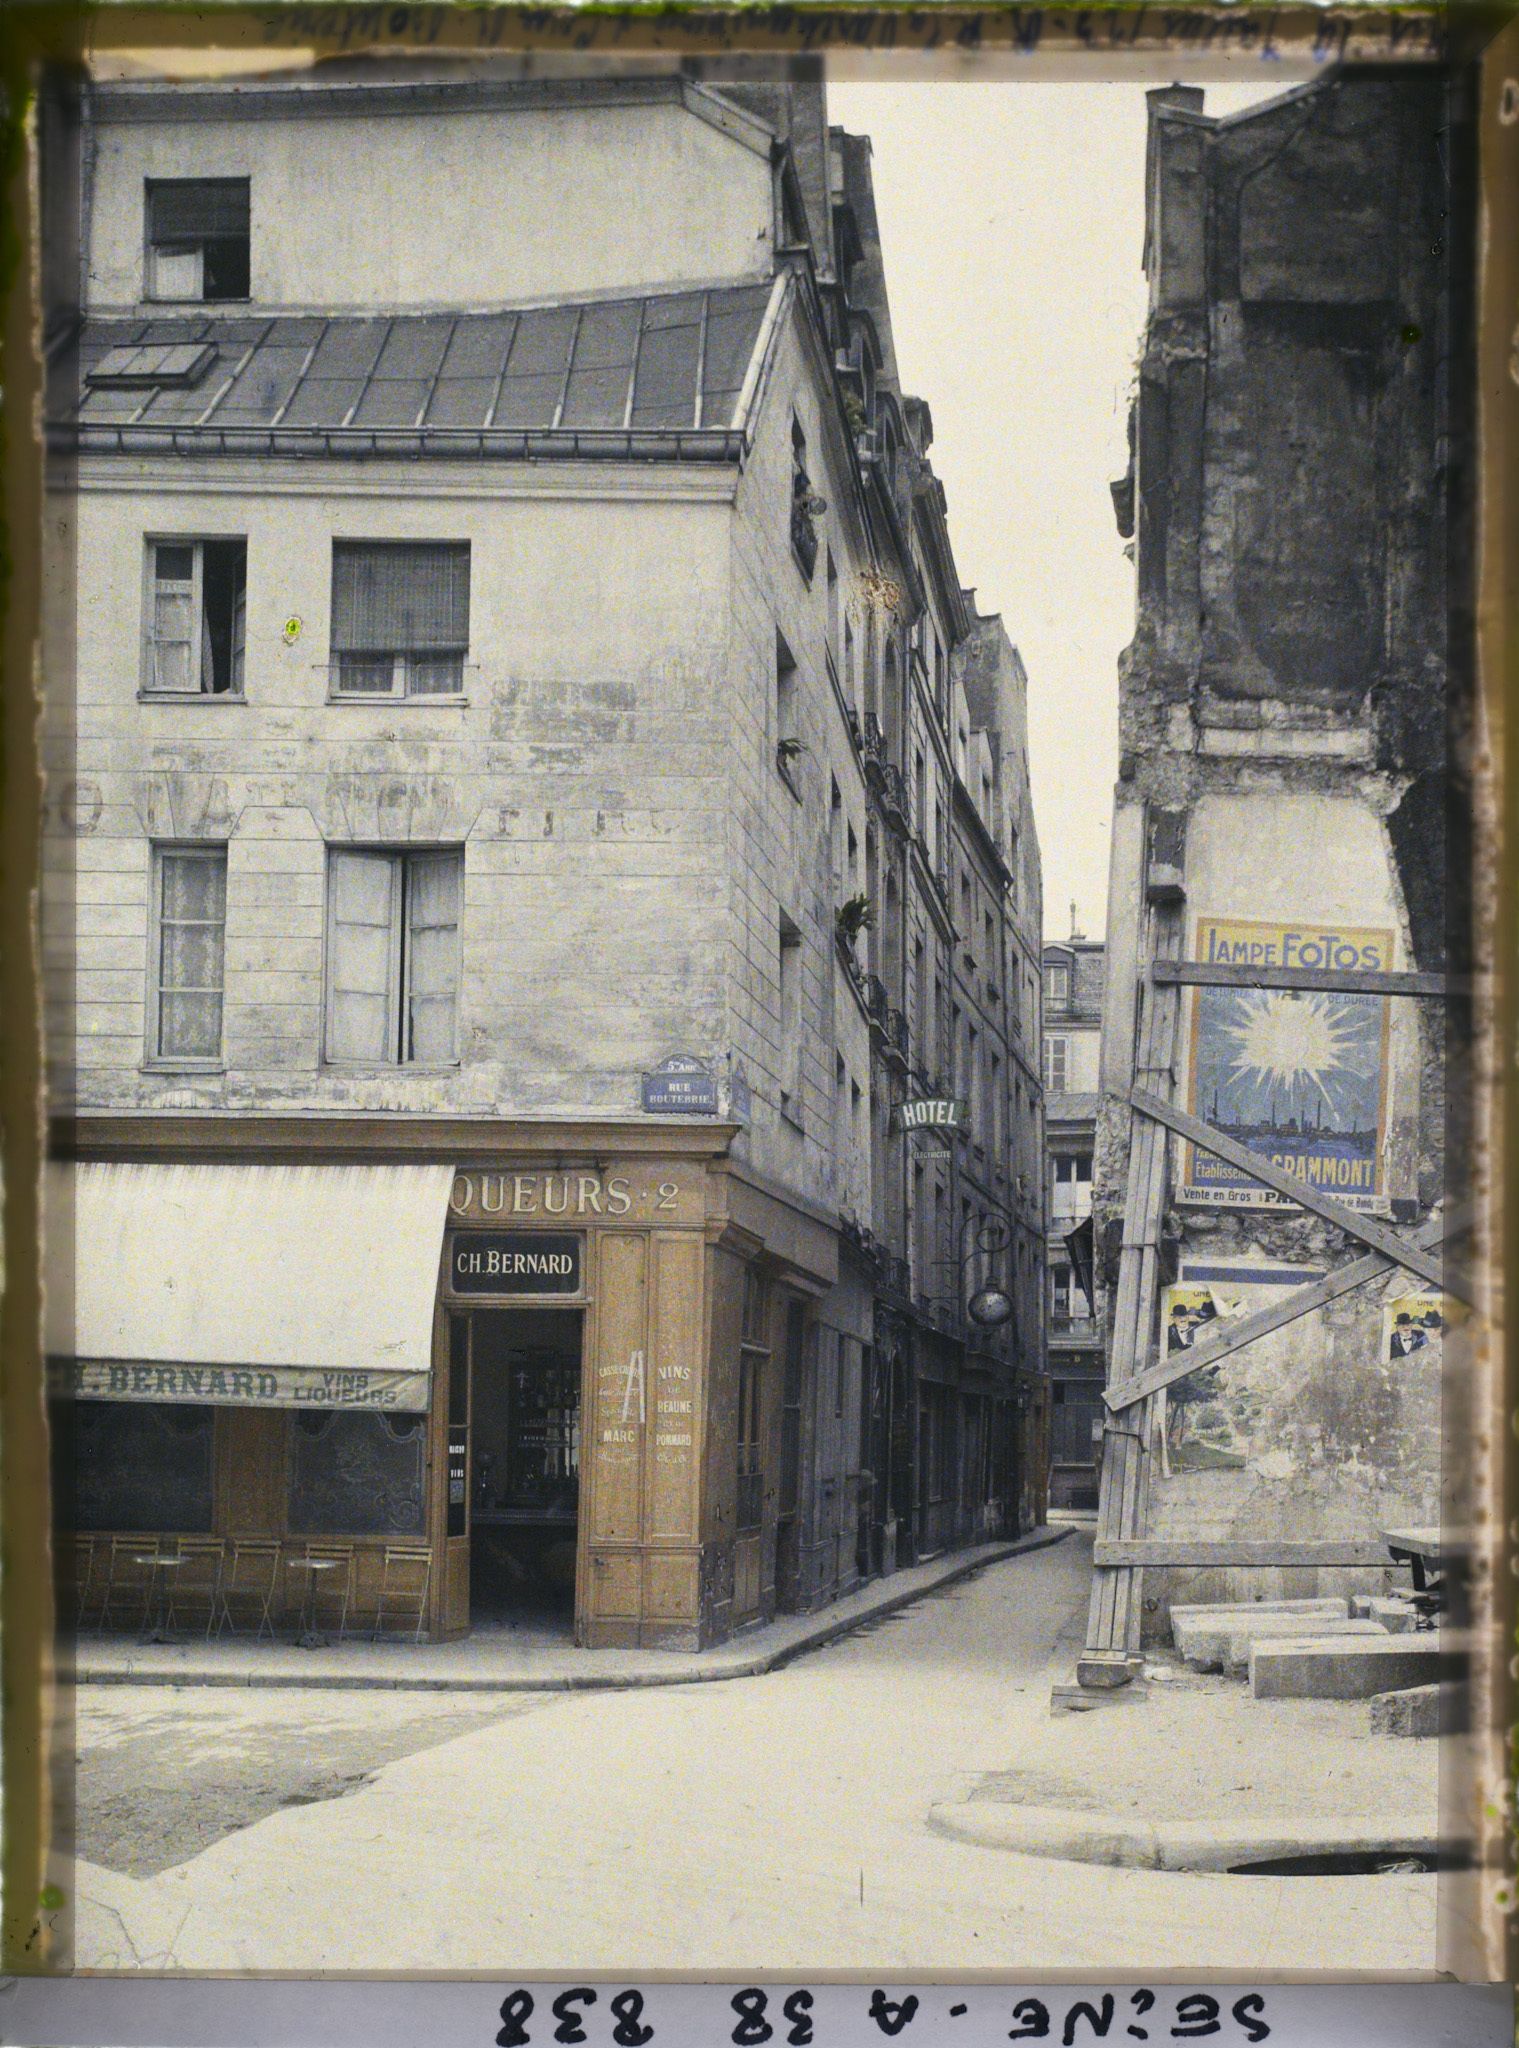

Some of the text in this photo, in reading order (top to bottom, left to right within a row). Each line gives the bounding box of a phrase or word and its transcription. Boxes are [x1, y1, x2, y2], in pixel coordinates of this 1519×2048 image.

[668, 1083, 691, 1092] RUE
[903, 1101, 957, 1127] HOTEL
[658, 1182, 680, 1210] 2
[1184, 1188, 1210, 1199] Vente
[1213, 1191, 1225, 1200] en
[1228, 1190, 1251, 1202] Gros
[486, 1250, 573, 1275] BERNARD
[323, 1373, 369, 1389] VINS
[658, 1365, 691, 1380] VINS
[106, 1366, 278, 1400] BERNARD
[293, 1387, 397, 1404] LIQUEURS
[657, 1400, 692, 1414] BEAUNE
[603, 1429, 636, 1443] MARC
[496, 1988, 655, 2046] 838
[730, 1988, 816, 2046] 38
